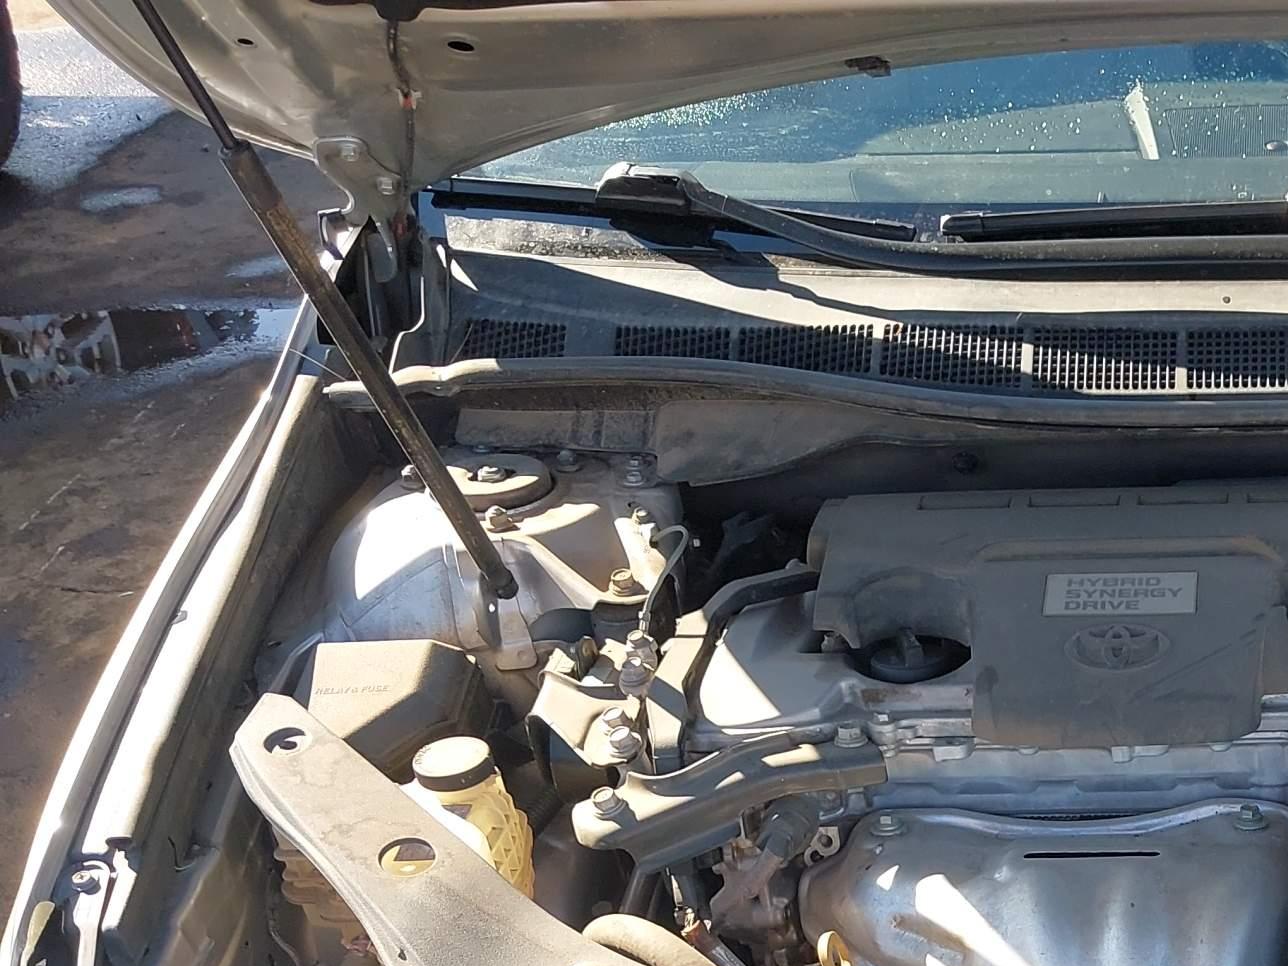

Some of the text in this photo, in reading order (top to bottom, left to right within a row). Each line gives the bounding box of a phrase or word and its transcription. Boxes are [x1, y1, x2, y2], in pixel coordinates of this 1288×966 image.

[1066, 576, 1162, 587] HYBRID
[1065, 587, 1184, 599] SYNERGY
[1063, 600, 1141, 611] DRIVE
